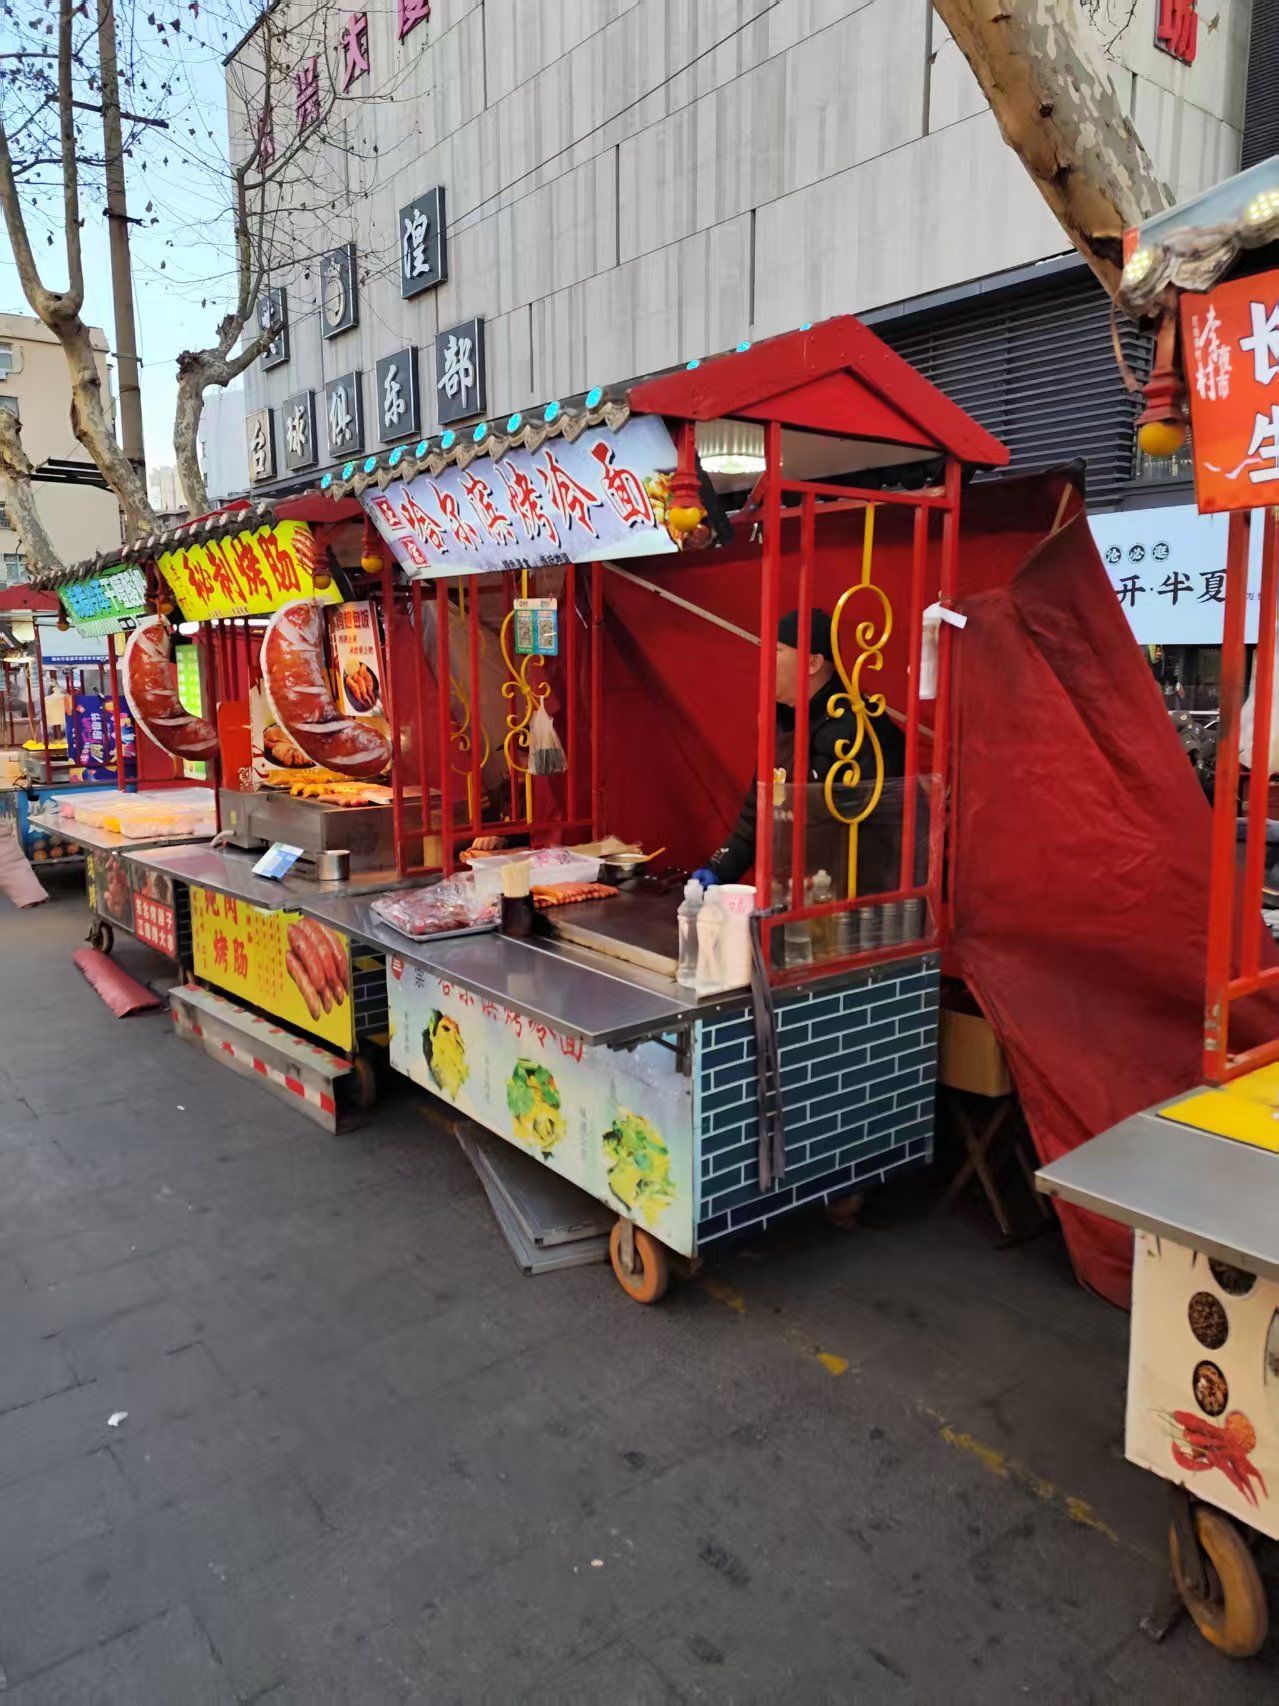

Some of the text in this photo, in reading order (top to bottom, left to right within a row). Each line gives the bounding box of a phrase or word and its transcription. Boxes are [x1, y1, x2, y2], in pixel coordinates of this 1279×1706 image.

[400, 440, 657, 553] 哈尔滨烤冷面
[183, 531, 302, 607] 秘制烤肠
[213, 929, 248, 979] 烤肠
